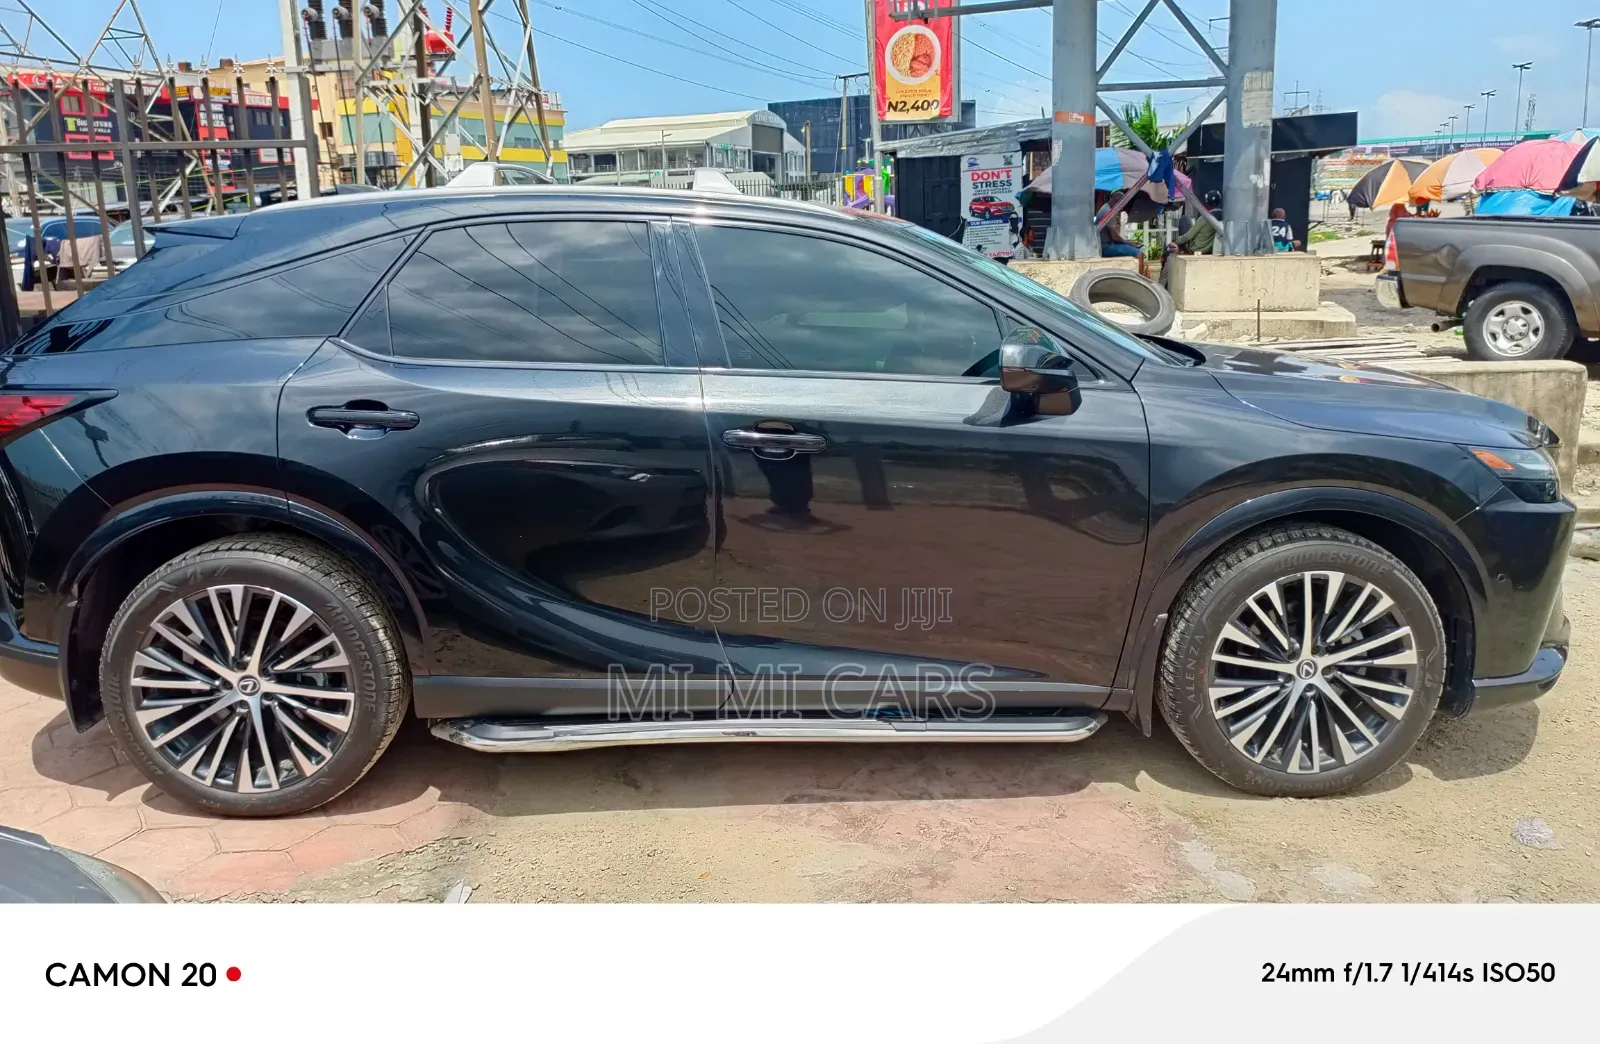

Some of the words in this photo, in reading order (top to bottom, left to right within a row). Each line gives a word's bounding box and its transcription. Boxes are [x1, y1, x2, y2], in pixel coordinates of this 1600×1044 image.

[887, 99, 940, 114] N2,400
[971, 169, 1012, 181] DON'T
[972, 179, 1013, 189] STRESS
[1272, 225, 1287, 237] 24
[1272, 550, 1388, 573] BRIDGESTONE
[1185, 635, 1205, 703] ALENZA
